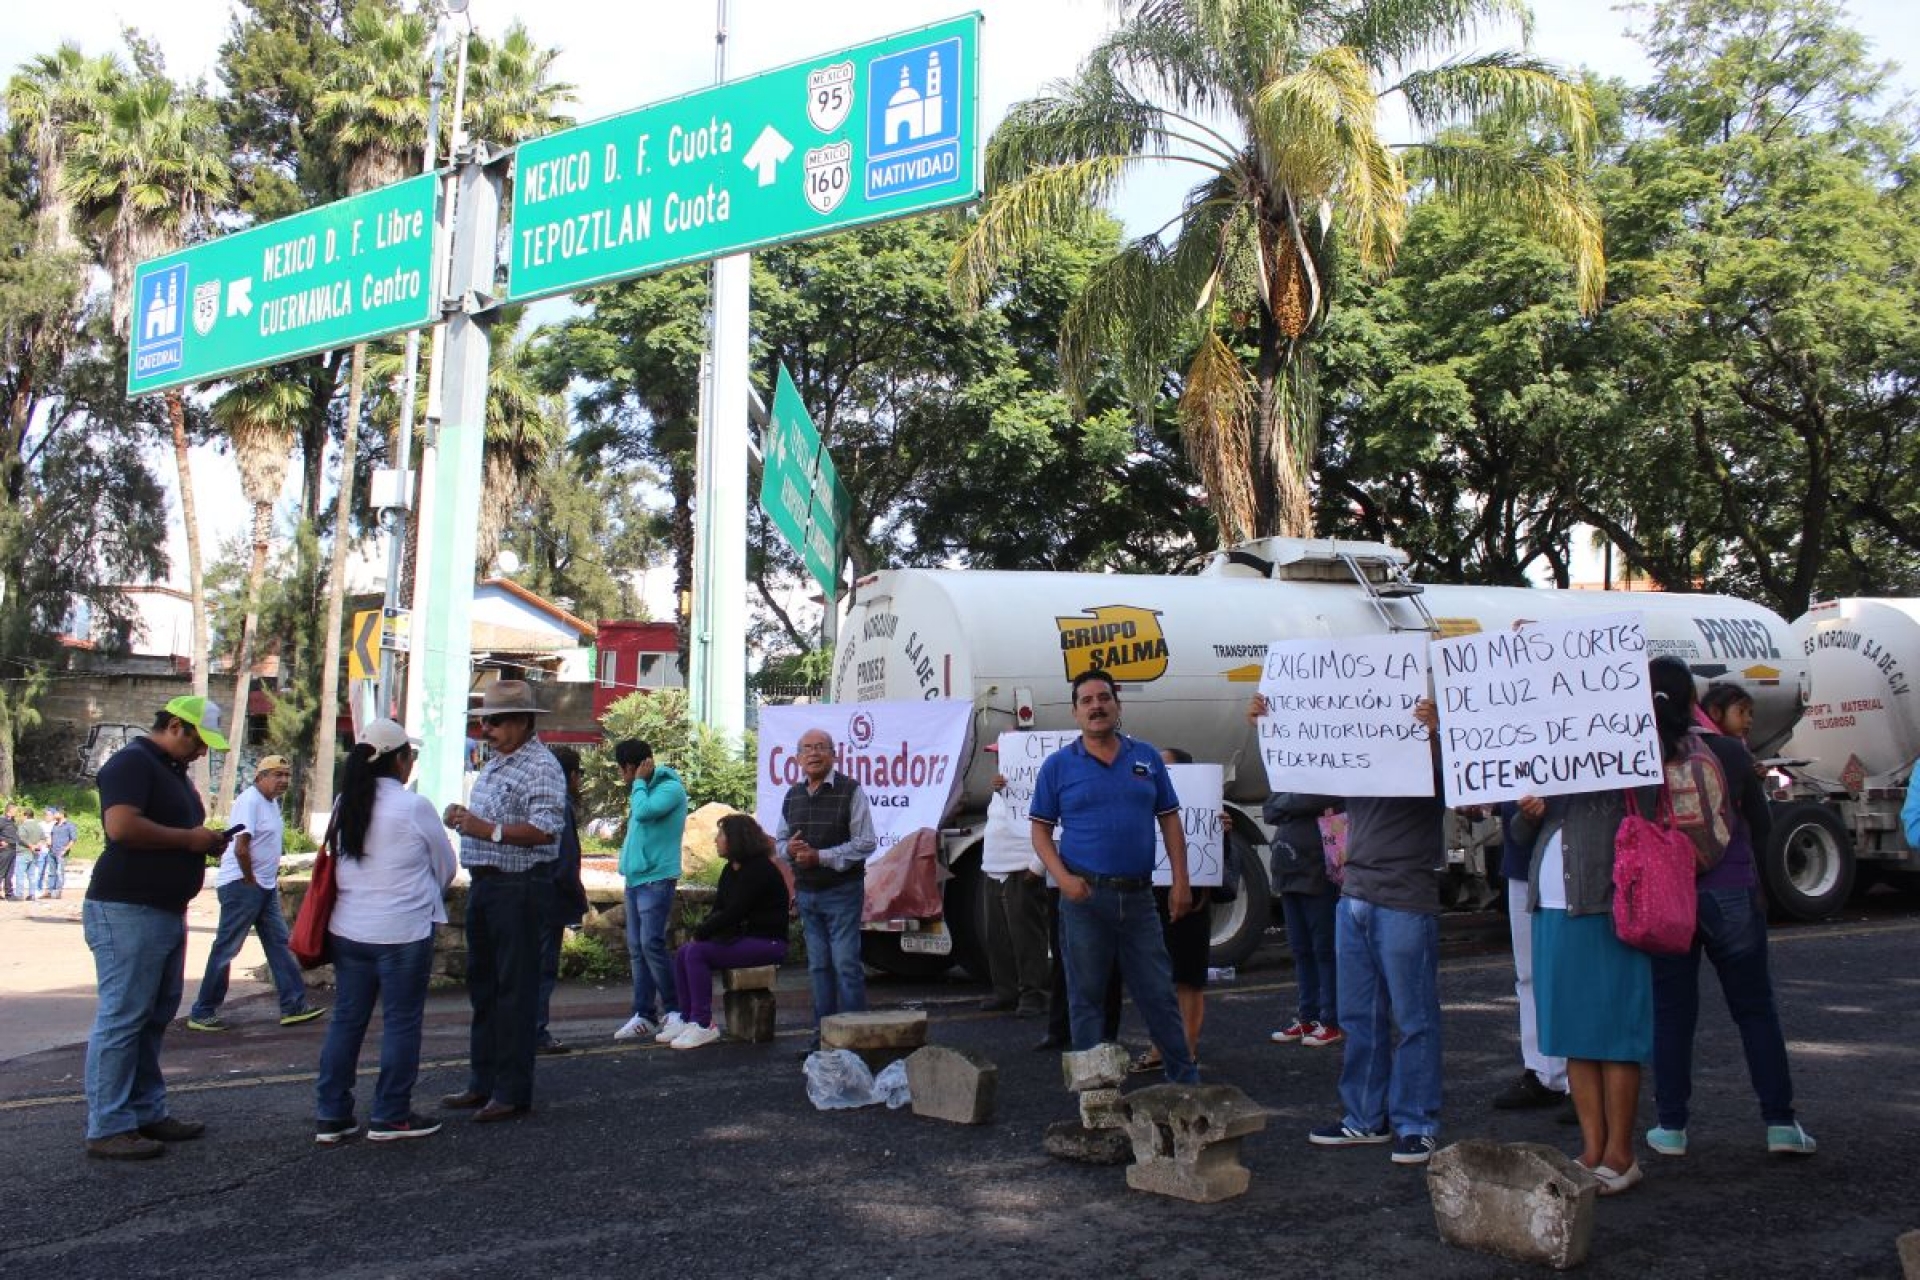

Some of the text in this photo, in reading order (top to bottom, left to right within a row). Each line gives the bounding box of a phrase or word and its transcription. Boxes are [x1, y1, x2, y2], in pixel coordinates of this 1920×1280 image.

[813, 68, 849, 85] MEXICO
[818, 87, 842, 112] 95
[524, 115, 733, 205] MEXICO D. F. Cuota
[809, 147, 847, 164] MEXICO
[871, 151, 954, 189] NATIVIDAD
[811, 166, 843, 194] 160
[522, 184, 730, 269] TEPOZTLAN Cuota
[263, 208, 423, 282] MEXICO D. F. Libre
[200, 299, 213, 318] 95
[260, 265, 420, 336] CUERNAVACA Centro
[138, 347, 180, 371] CATEDRAL
[1061, 620, 1137, 650] GRUPO
[1090, 637, 1170, 670] SALMA
[1442, 643, 1477, 677] NO
[1489, 627, 1554, 669] MÁS
[1563, 624, 1646, 660] CORTES
[1804, 636, 1815, 656] ES
[1877, 652, 1896, 675] DE
[1266, 650, 1420, 681] EXIGIMOS LA
[1264, 688, 1392, 713] NTERVENCIÓN
[1444, 661, 1640, 713] DE LUZ A LOS
[1841, 698, 1884, 713] MATERIAL
[1261, 722, 1429, 742] LAS AUTORIDADES
[1450, 712, 1655, 753] POZOS DE AGUA
[1813, 714, 1855, 731] PELIGROSO
[769, 741, 949, 788] Codinadora
[1266, 749, 1371, 769] FEDERALES
[1515, 762, 1531, 778] NO
[869, 794, 909, 808] vaca
